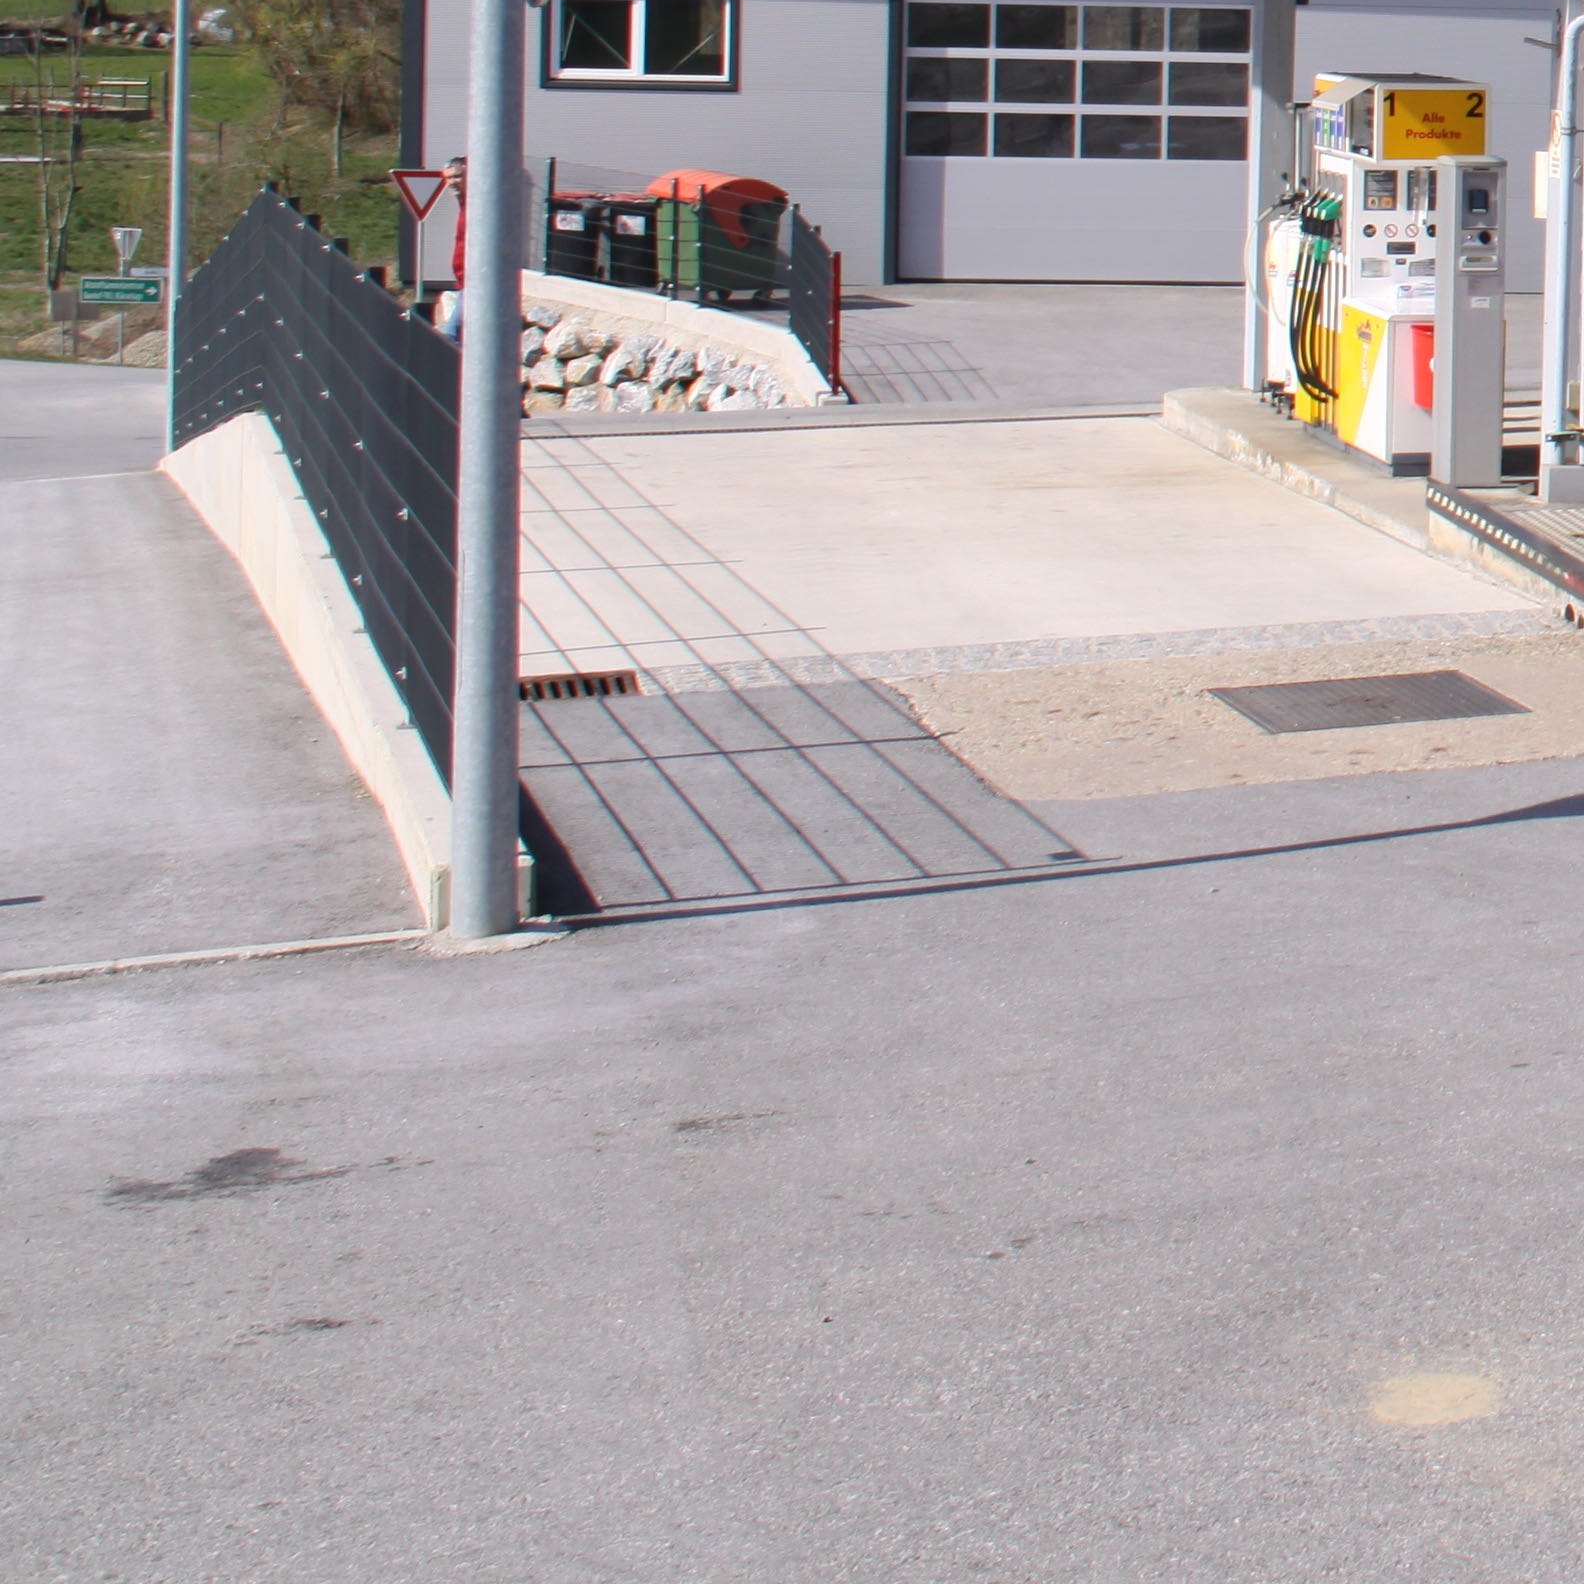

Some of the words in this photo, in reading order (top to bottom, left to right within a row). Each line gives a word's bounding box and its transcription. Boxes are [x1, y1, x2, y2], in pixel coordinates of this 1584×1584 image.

[1383, 92, 1396, 117] 1
[1466, 92, 1485, 118] 2
[1422, 112, 1446, 123] Alle
[1405, 127, 1462, 139] Produkte
